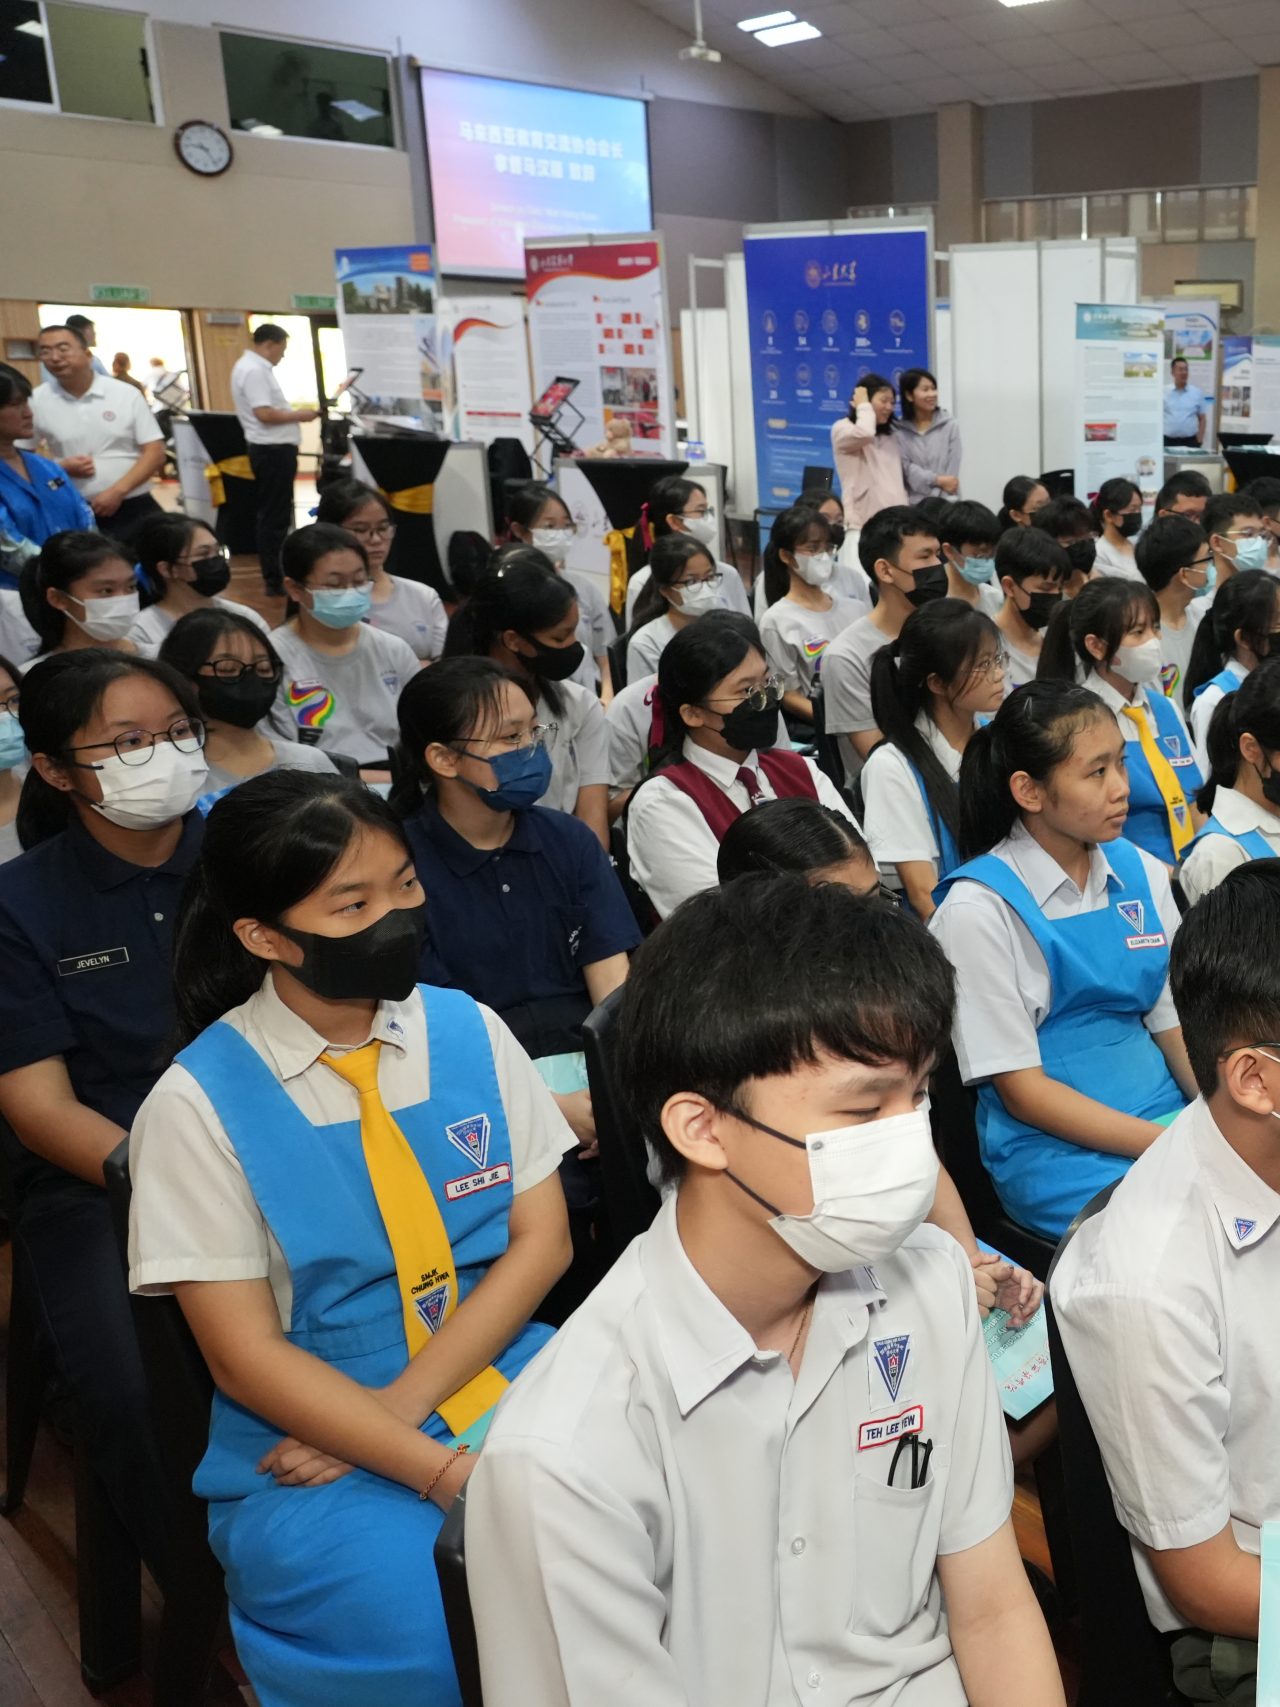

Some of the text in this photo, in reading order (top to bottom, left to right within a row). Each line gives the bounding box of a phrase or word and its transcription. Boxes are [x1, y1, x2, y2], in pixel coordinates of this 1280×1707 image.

[77, 955, 110, 969] JEVELYN
[455, 1171, 500, 1193] LEE SHI JIE
[411, 1271, 450, 1295] CHUNG HWA
[420, 1267, 439, 1282] SMJK
[866, 1426, 883, 1441] TEH
[885, 1422, 899, 1436] LEE
